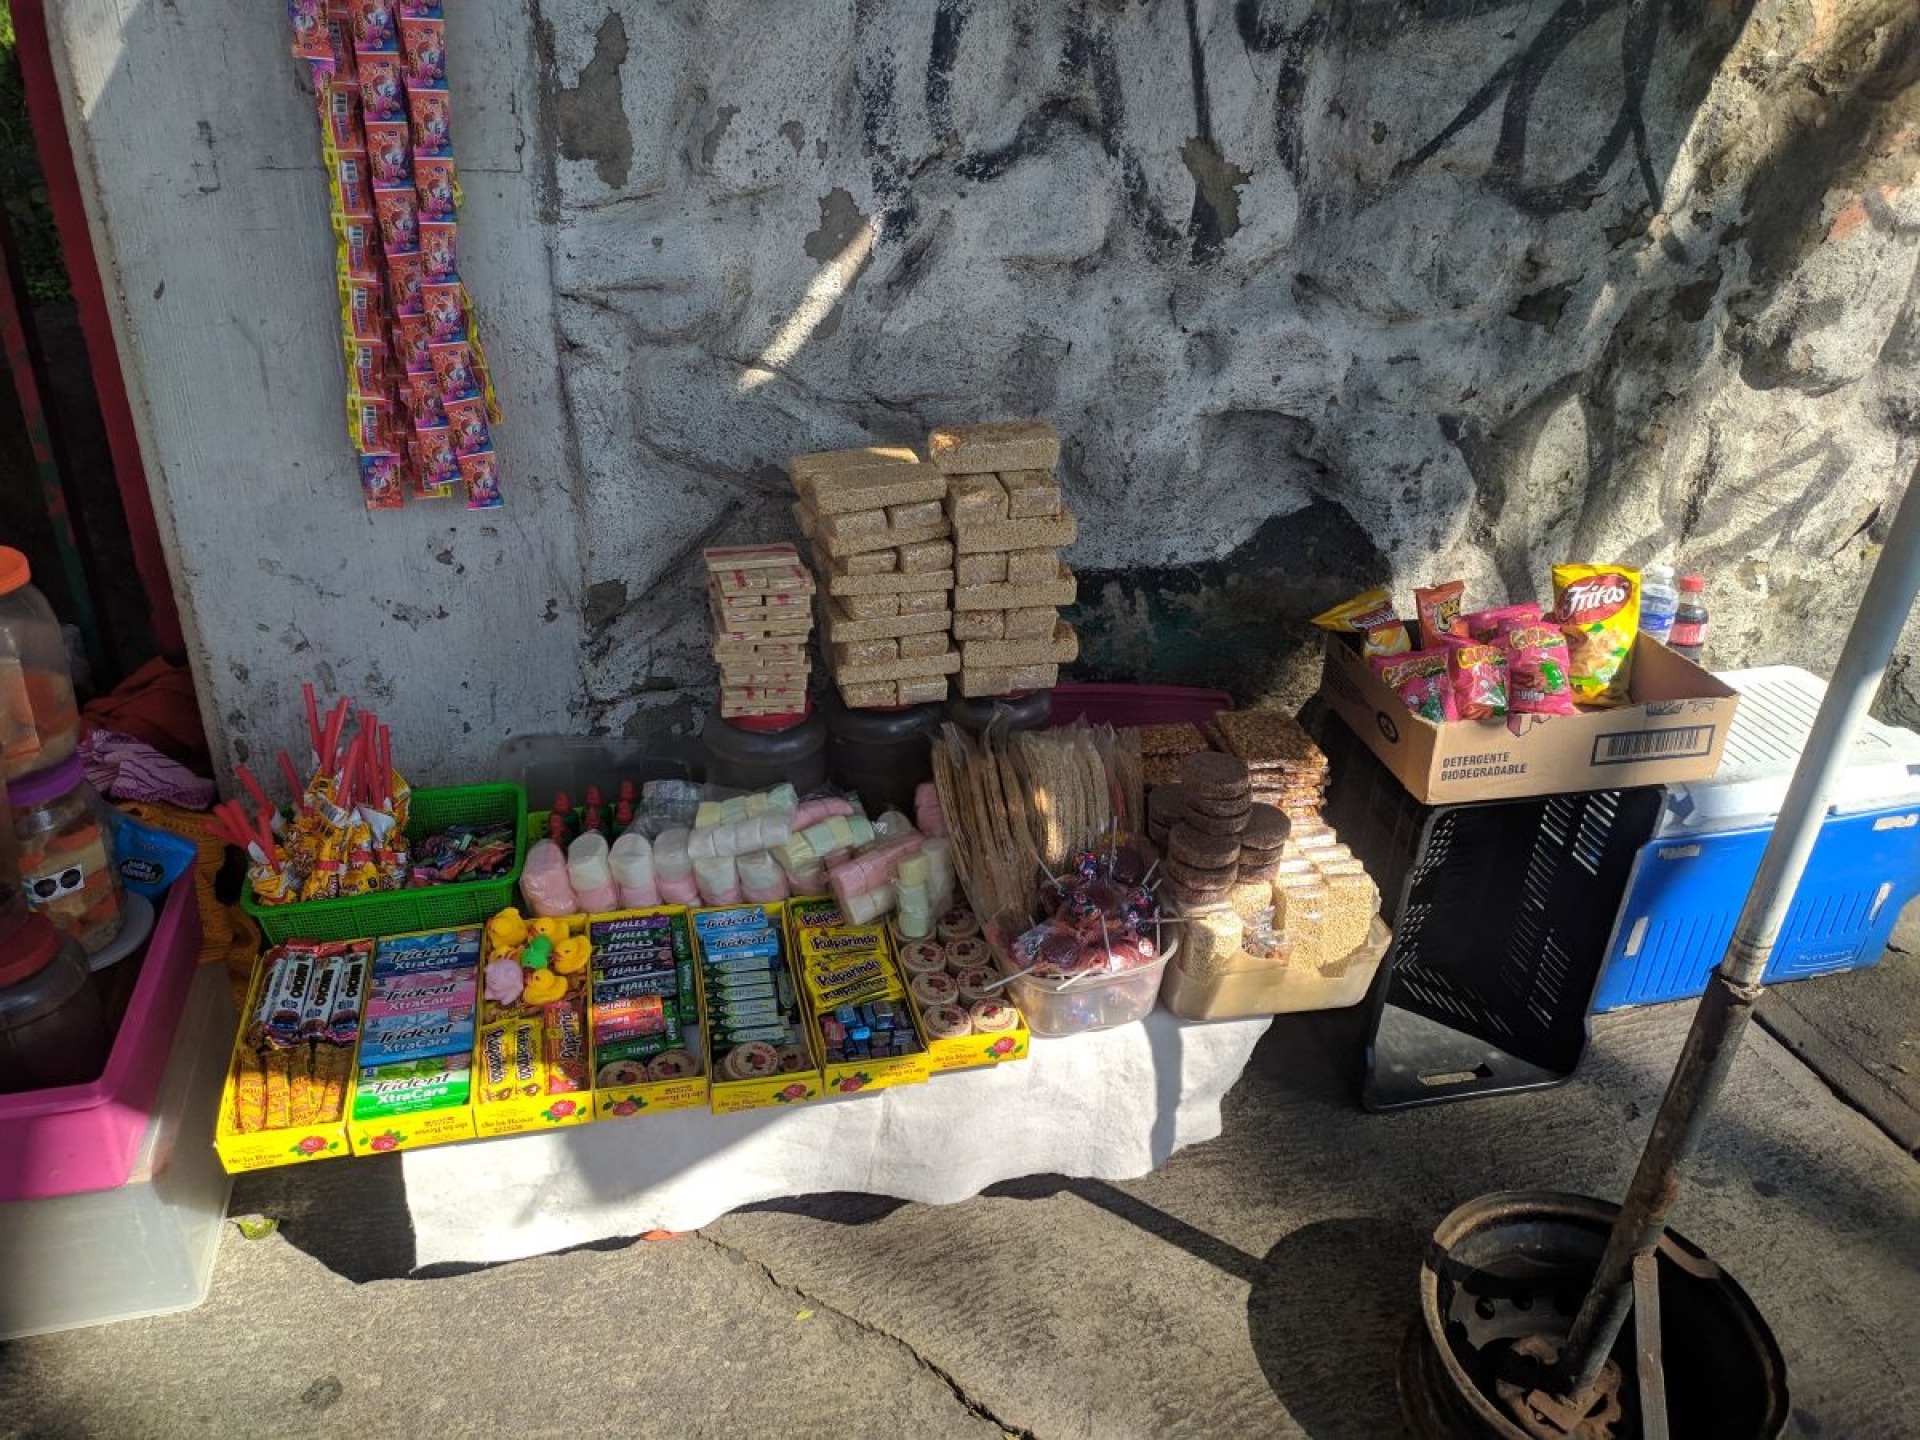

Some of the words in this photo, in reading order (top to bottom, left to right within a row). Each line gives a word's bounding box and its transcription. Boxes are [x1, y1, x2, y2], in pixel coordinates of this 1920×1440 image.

[1567, 581, 1626, 618] Fritos
[1442, 751, 1511, 769] DETERGENTE
[1441, 762, 1528, 781] BIODEGRADABLE
[609, 919, 648, 931] HALLS
[611, 929, 651, 942] HALLS
[811, 935, 878, 950] Pulparindo
[391, 945, 461, 963] Trident
[394, 956, 459, 971] XtraCare
[815, 960, 881, 989] Pulparindo
[385, 983, 456, 1002] Trident
[389, 996, 456, 1011] XtraCare
[380, 1024, 454, 1043] Trident
[383, 1037, 451, 1053] XtraCare
[374, 1072, 451, 1093] Trident
[378, 1087, 449, 1104] XtraCare
